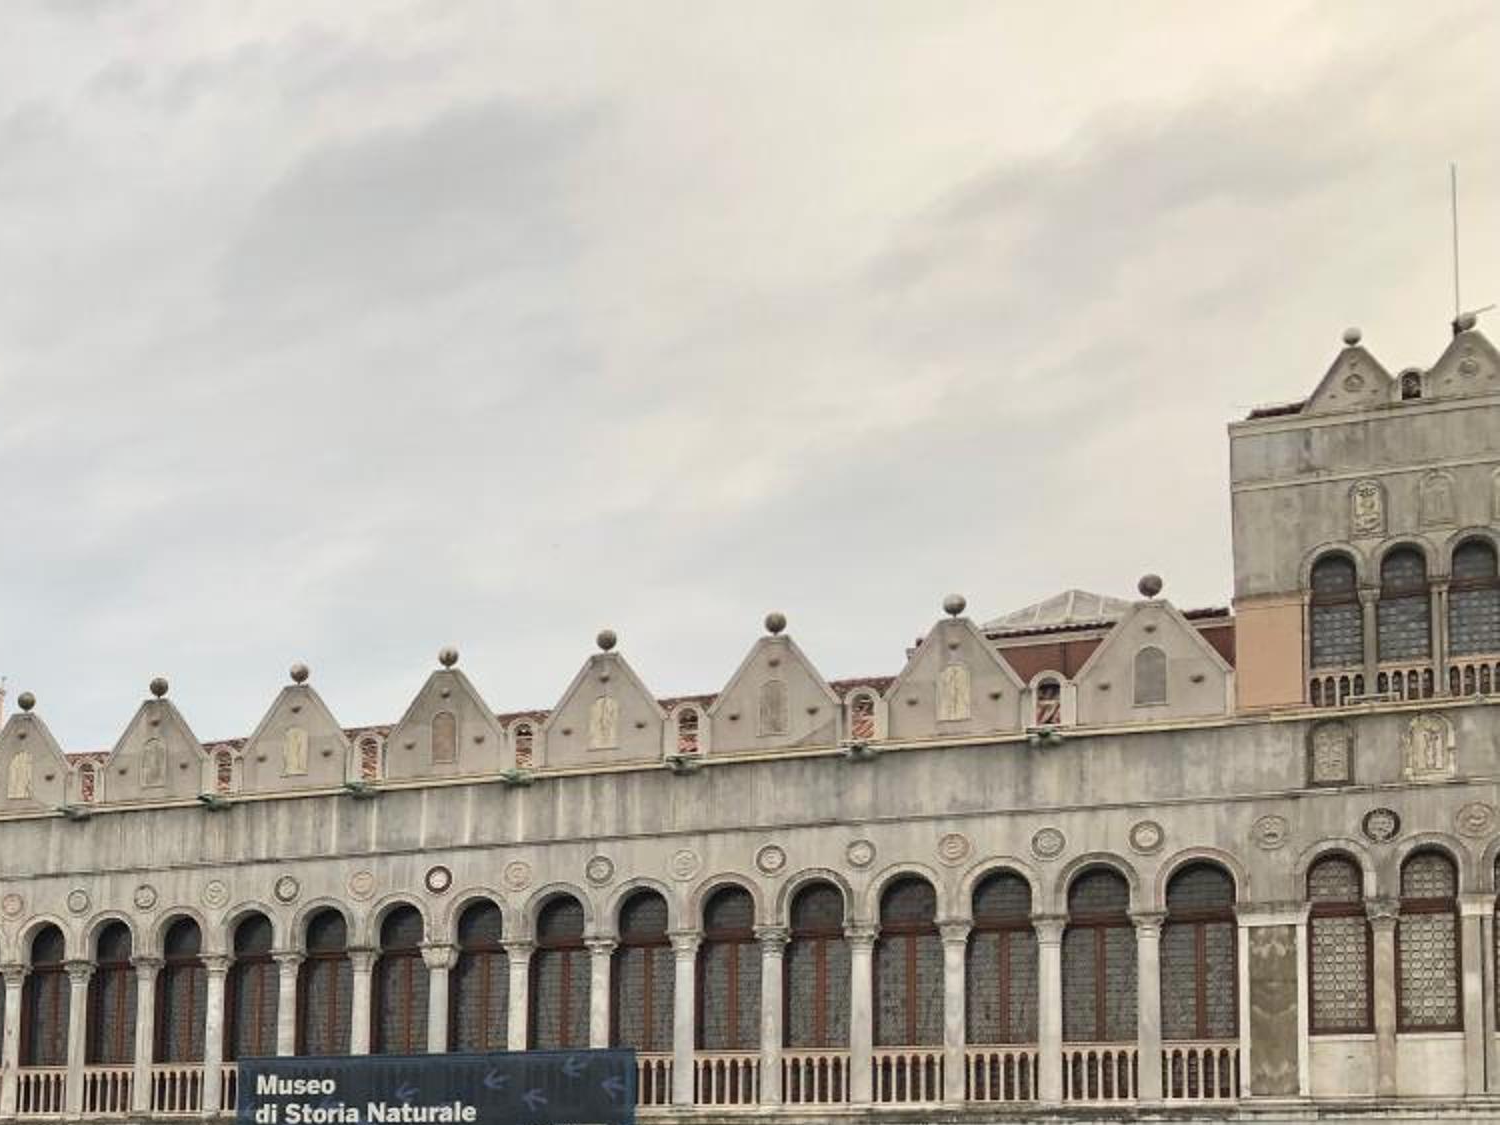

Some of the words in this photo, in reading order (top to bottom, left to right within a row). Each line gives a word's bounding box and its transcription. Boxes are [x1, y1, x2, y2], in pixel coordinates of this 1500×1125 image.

[256, 1074, 336, 1095] Museo
[255, 1103, 277, 1124] di
[285, 1103, 359, 1124] Storia
[367, 1101, 478, 1124] Naturale
